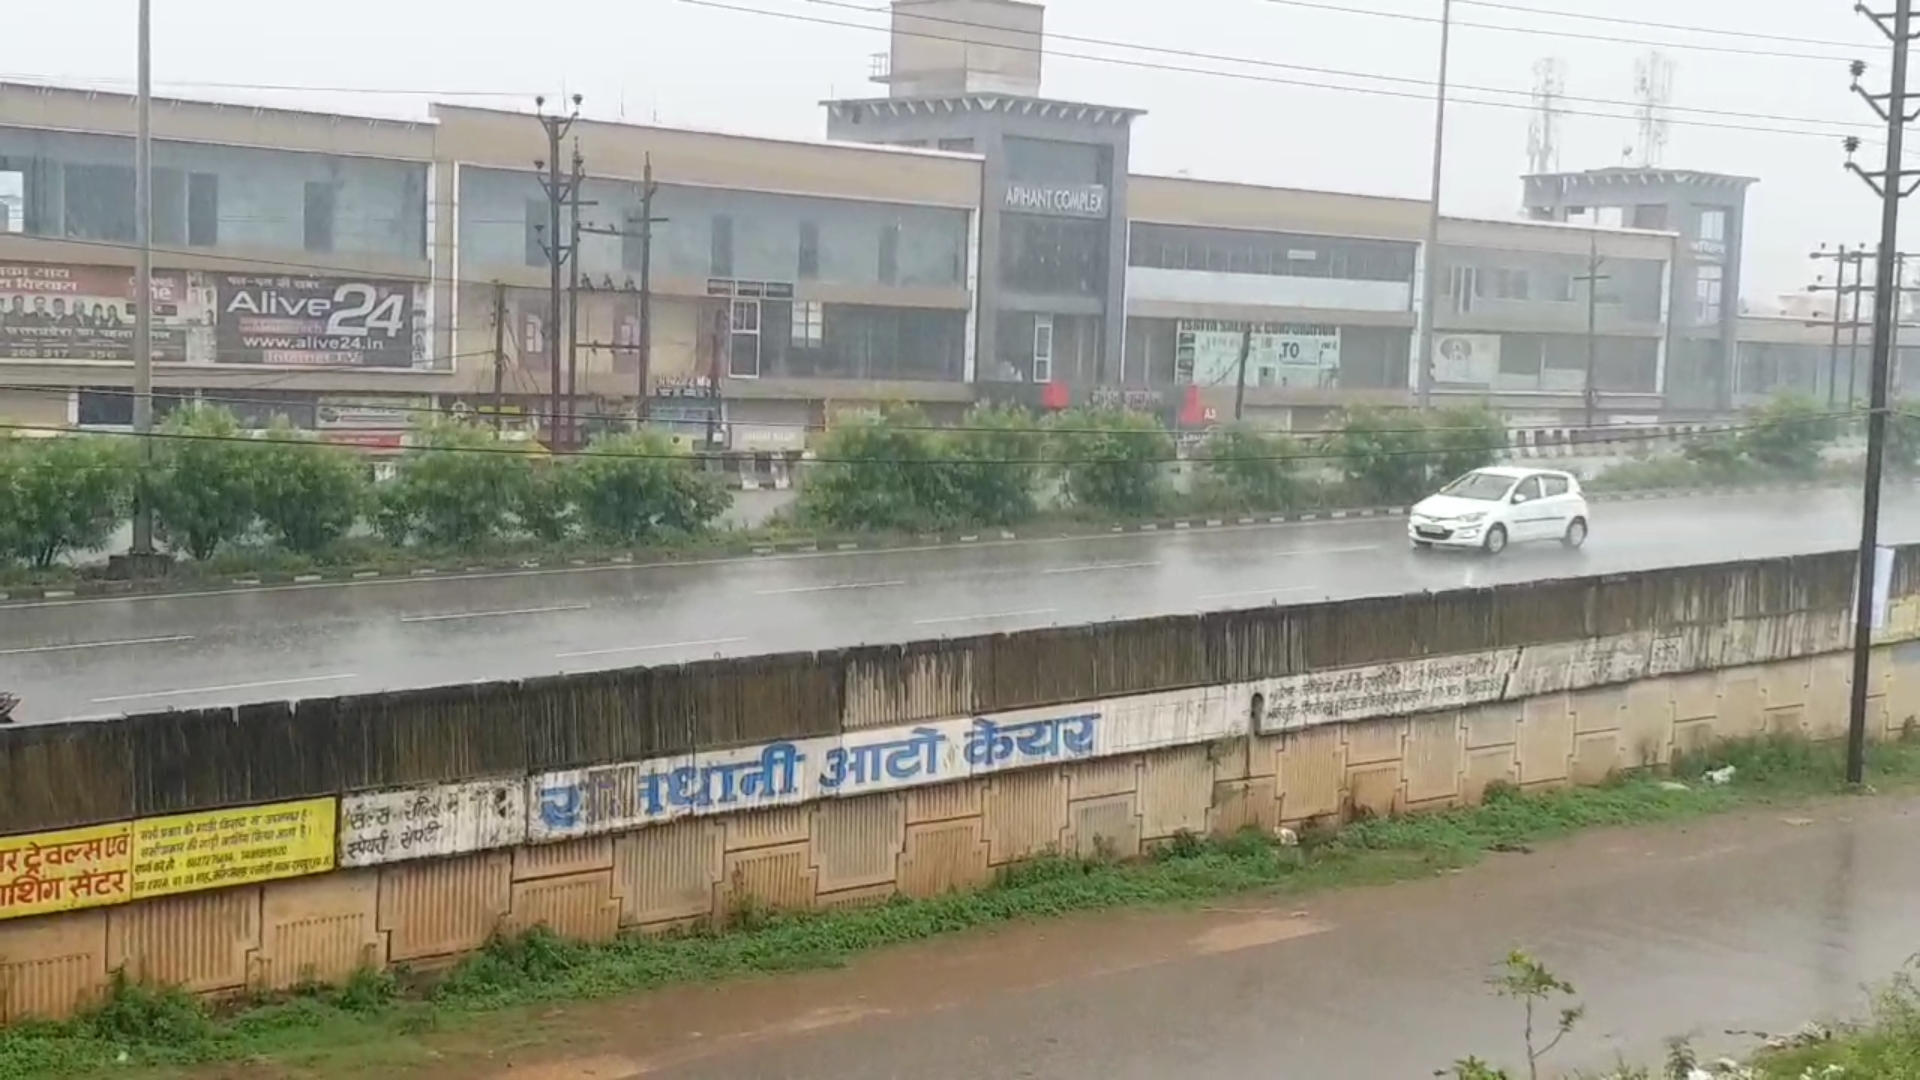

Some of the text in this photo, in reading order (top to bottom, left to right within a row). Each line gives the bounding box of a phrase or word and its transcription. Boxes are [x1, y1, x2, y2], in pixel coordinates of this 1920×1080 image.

[1054, 190, 1103, 212] COMPLEX
[226, 290, 331, 316] Alive
[325, 283, 405, 338] 24
[243, 336, 384, 350] www.alive24.in
[964, 713, 1102, 767] केयर
[23, 840, 104, 876] ट्रेवल्स
[105, 827, 131, 858] एवं
[69, 867, 128, 898] सेंटर
